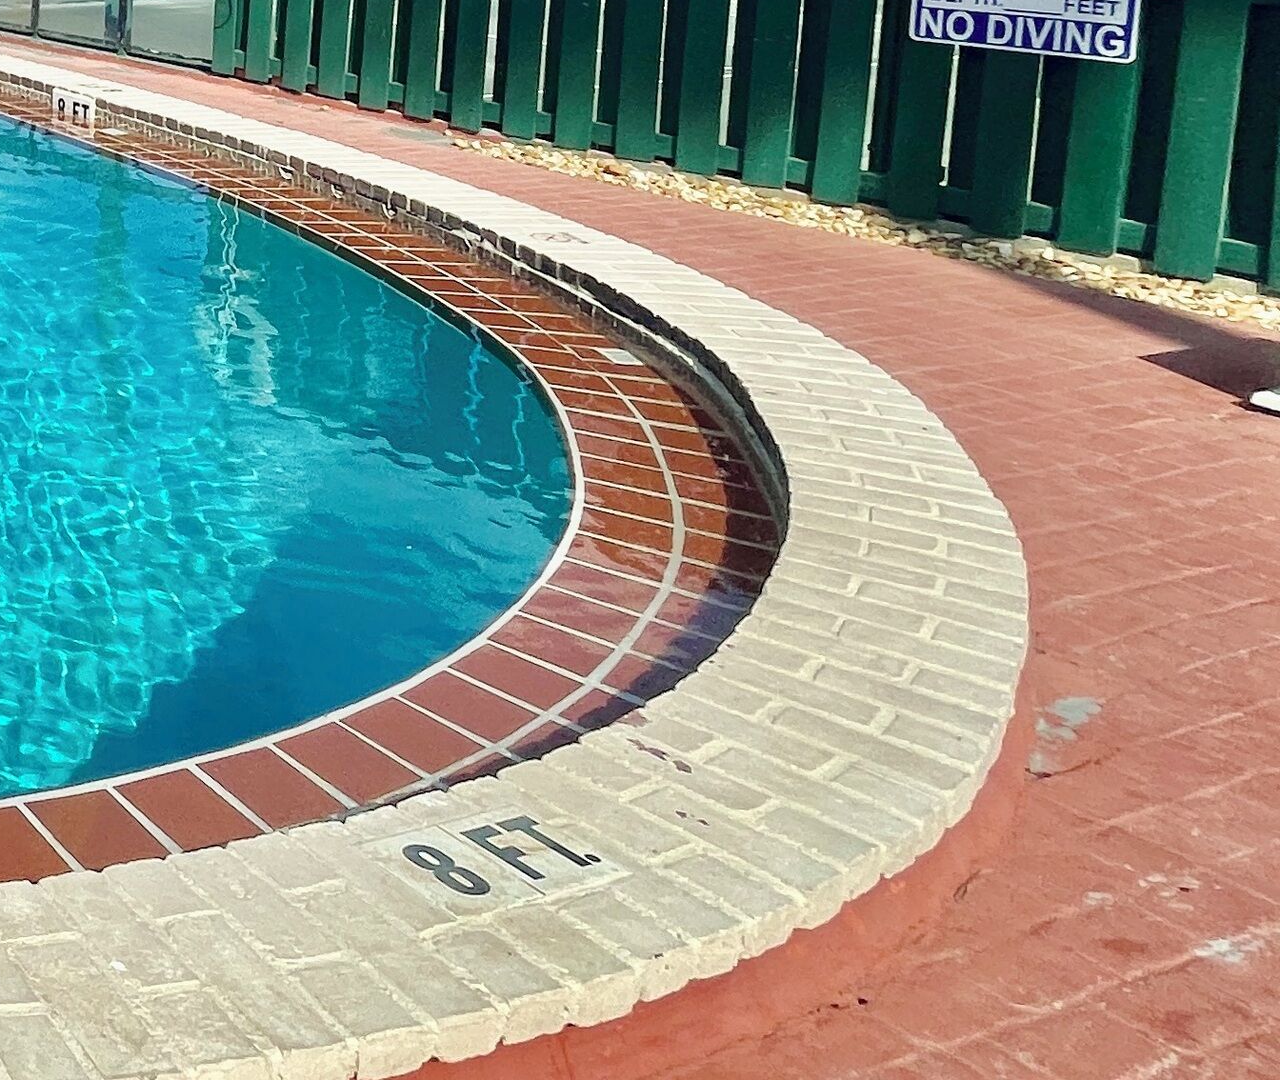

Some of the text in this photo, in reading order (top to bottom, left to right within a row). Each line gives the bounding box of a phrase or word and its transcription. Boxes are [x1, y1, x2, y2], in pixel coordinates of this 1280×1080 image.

[919, 8, 1126, 58] NO DIVING
[401, 814, 602, 896] 8 FT.
